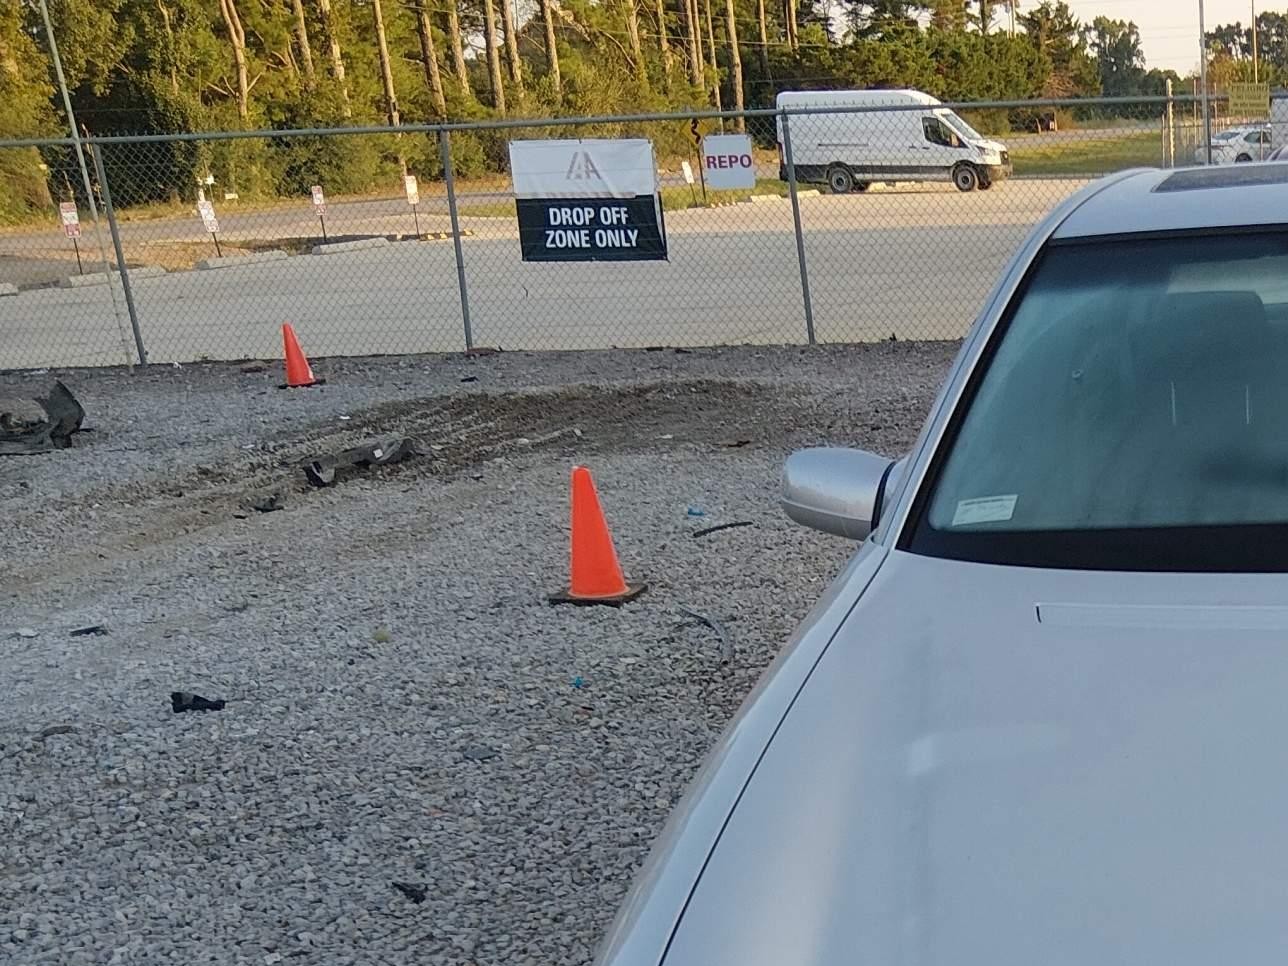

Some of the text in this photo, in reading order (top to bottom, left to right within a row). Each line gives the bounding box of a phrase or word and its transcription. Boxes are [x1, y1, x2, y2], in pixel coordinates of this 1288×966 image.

[705, 153, 753, 170] REPO
[548, 207, 629, 226] DROP OFF
[545, 229, 639, 249] ZONE ONLY
